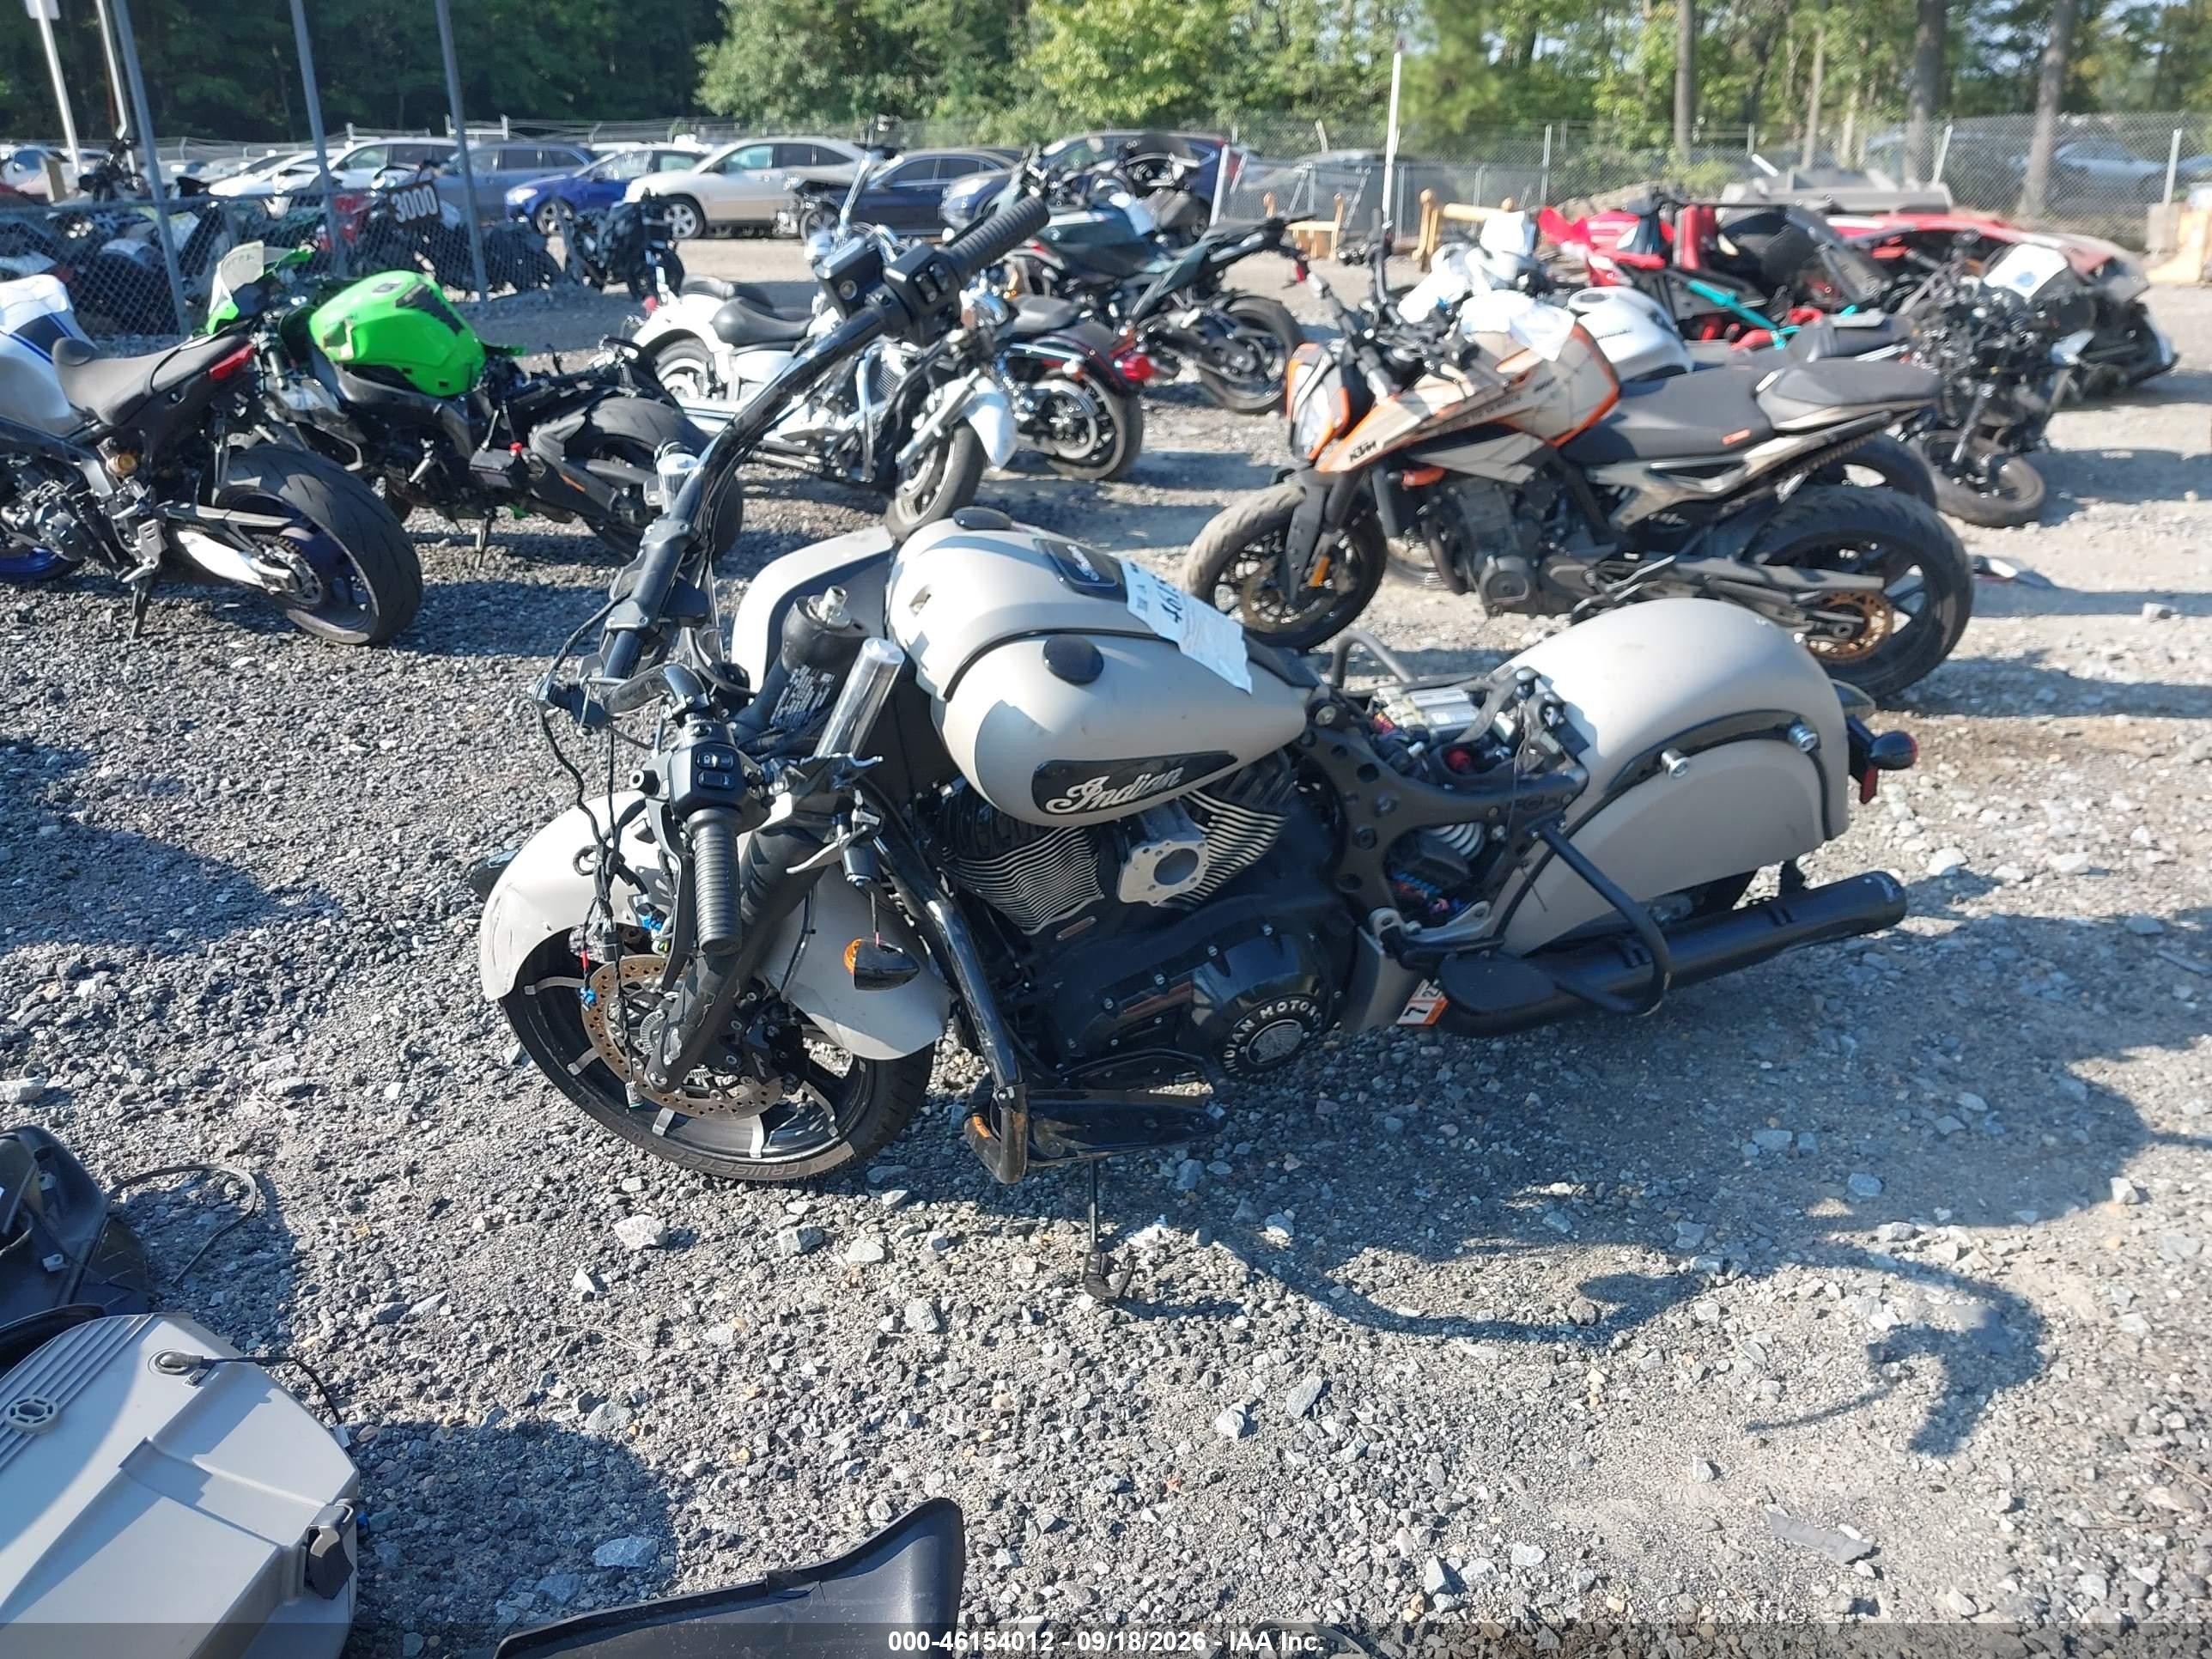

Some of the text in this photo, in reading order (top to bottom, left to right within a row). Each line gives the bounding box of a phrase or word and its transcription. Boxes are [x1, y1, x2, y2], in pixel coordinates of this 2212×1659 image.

[391, 184, 439, 223] 3000
[1349, 441, 1376, 463] KTM
[1045, 766, 1184, 814] Indian
[1223, 1018, 1255, 1073] INDIAN
